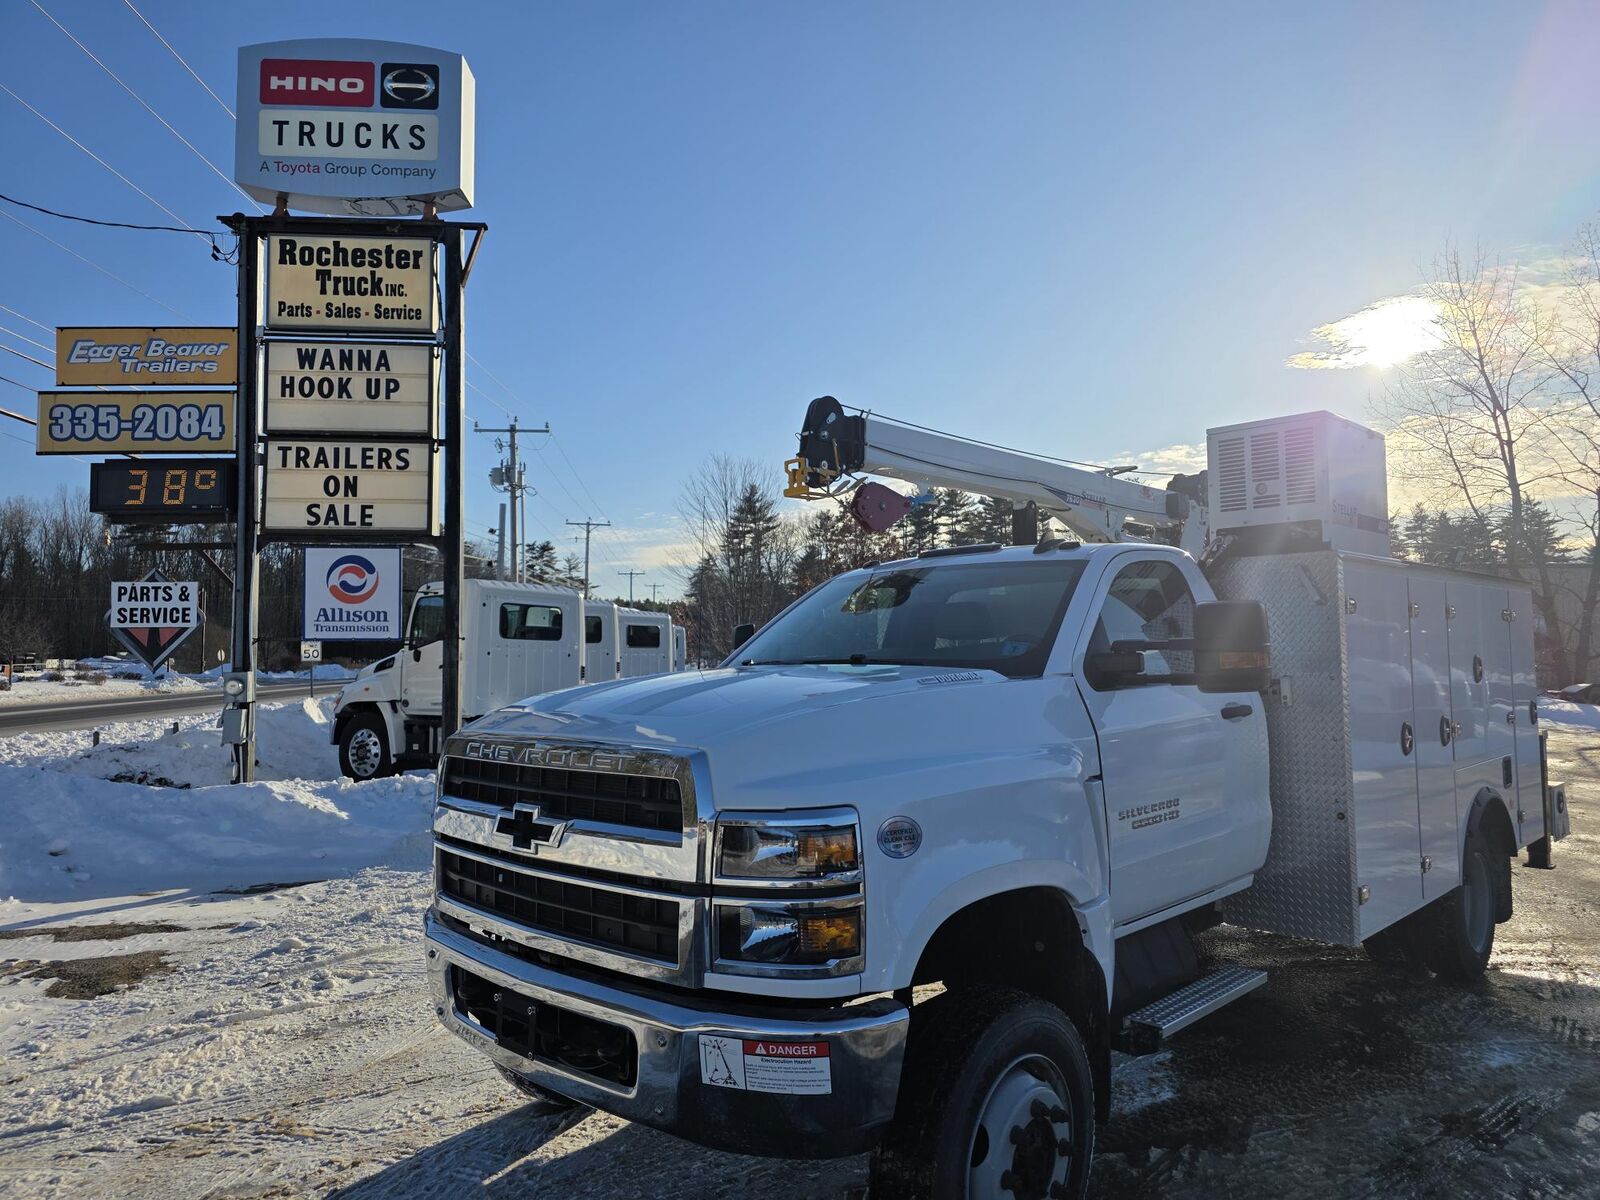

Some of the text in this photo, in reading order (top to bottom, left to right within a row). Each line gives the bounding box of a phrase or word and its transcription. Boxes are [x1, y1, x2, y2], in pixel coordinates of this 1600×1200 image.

[269, 75, 365, 93] HINO
[272, 120, 426, 151] TRUCKS
[259, 161, 436, 179] A Toyota Group Company
[278, 238, 423, 270] Rochester
[315, 269, 408, 298] Truck INC.
[277, 301, 422, 320] Parts Sales Service
[67, 337, 229, 363] Eager Beaver
[296, 347, 391, 372] WANNA
[119, 357, 218, 374] Trailers
[280, 376, 400, 400] HOOK UP
[49, 403, 225, 442] 335-2084
[277, 446, 410, 471] TRAILERS
[323, 475, 358, 498] ON
[305, 503, 374, 527] SALE
[117, 585, 190, 602] PARTS &
[117, 606, 191, 624] SERVICE
[314, 607, 389, 623] Allison
[313, 623, 389, 633] Transmission
[303, 649, 320, 659] 50
[465, 742, 636, 771] CHEVROLET
[1118, 798, 1180, 821] SILVERADO
[769, 1045, 817, 1055] DANGER
